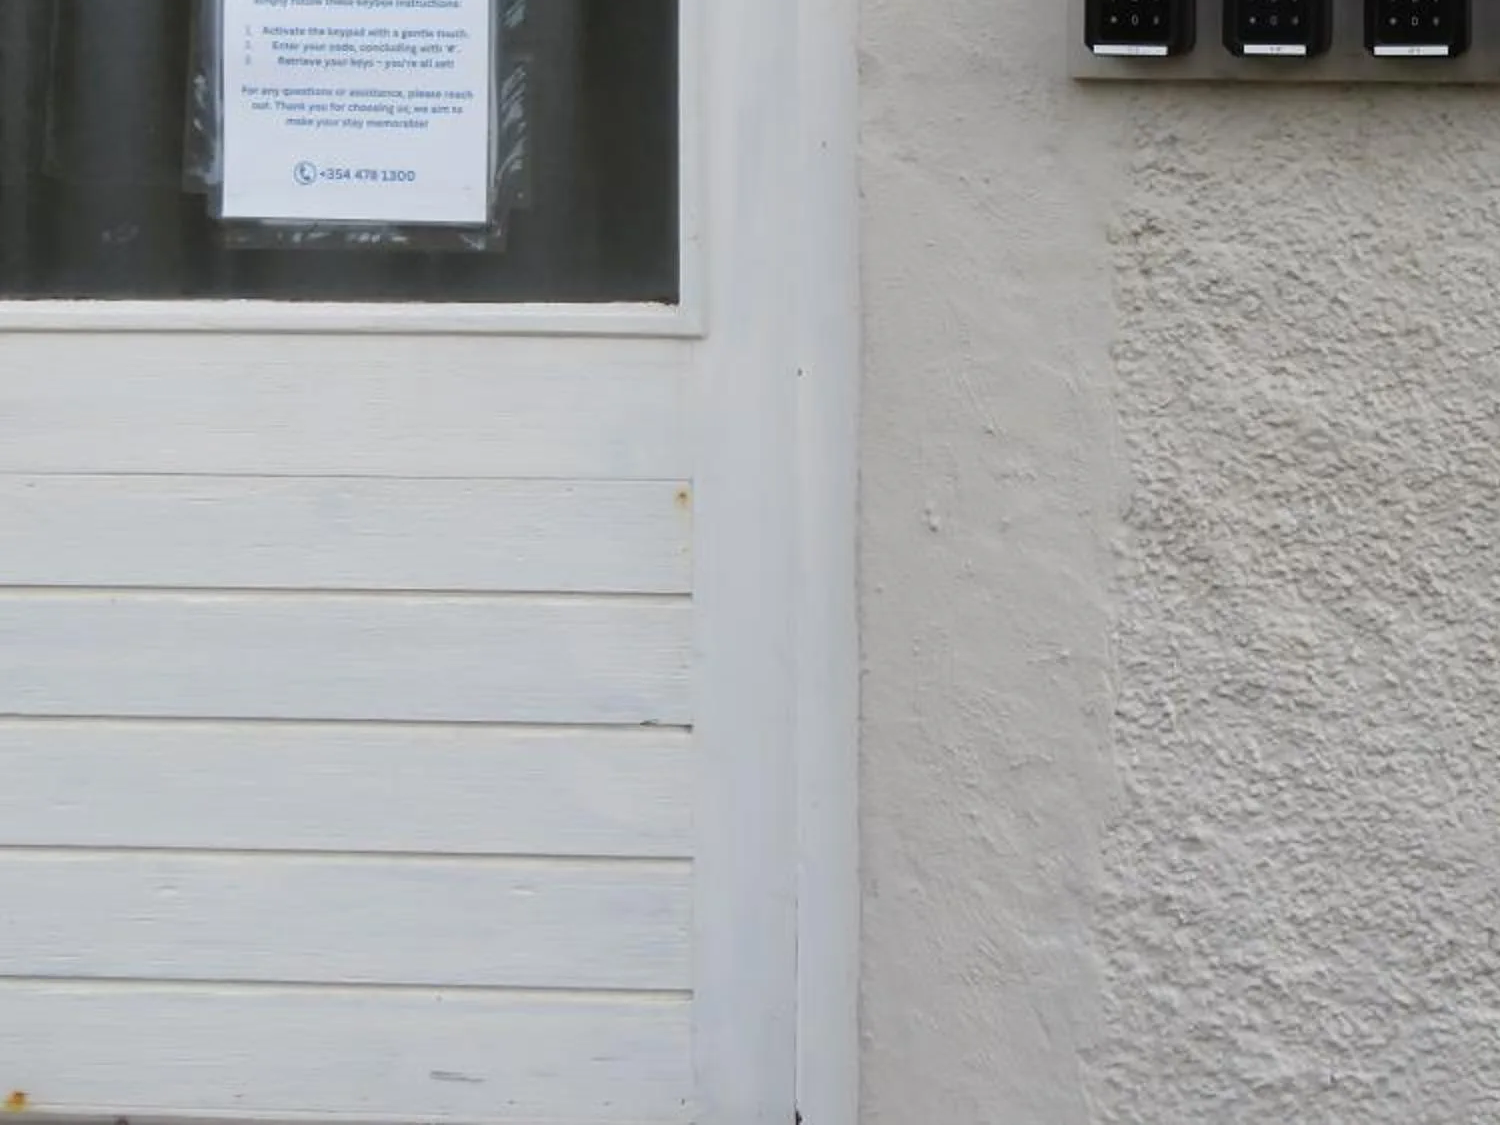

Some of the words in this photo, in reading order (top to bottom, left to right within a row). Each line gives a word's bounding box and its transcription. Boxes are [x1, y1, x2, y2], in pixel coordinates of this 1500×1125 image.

[262, 26, 304, 36] Activate
[308, 26, 324, 36] the
[327, 27, 365, 38] keypad
[368, 27, 391, 37] with
[401, 28, 434, 39] gentle
[272, 40, 298, 50] Enter
[303, 42, 327, 53] your
[359, 42, 417, 54] concluding
[420, 43, 442, 53] with
[277, 56, 321, 66] Retrieve
[324, 57, 348, 69] your
[350, 57, 374, 68] keys
[420, 58, 432, 69] all
[241, 86, 259, 96] For
[261, 87, 280, 98] any
[283, 87, 333, 98] questions
[335, 88, 346, 97] or
[407, 88, 442, 100] please
[444, 90, 473, 100] reach
[275, 101, 305, 111] Thank
[308, 102, 327, 113] you
[329, 101, 345, 111] for
[348, 102, 395, 115] choosing
[414, 105, 429, 114] we
[431, 104, 449, 114] aim
[451, 104, 463, 114] to
[286, 116, 313, 126] make
[316, 117, 339, 129] your
[341, 117, 364, 129] stay
[319, 168, 351, 180] +354
[382, 169, 416, 182] 1300
